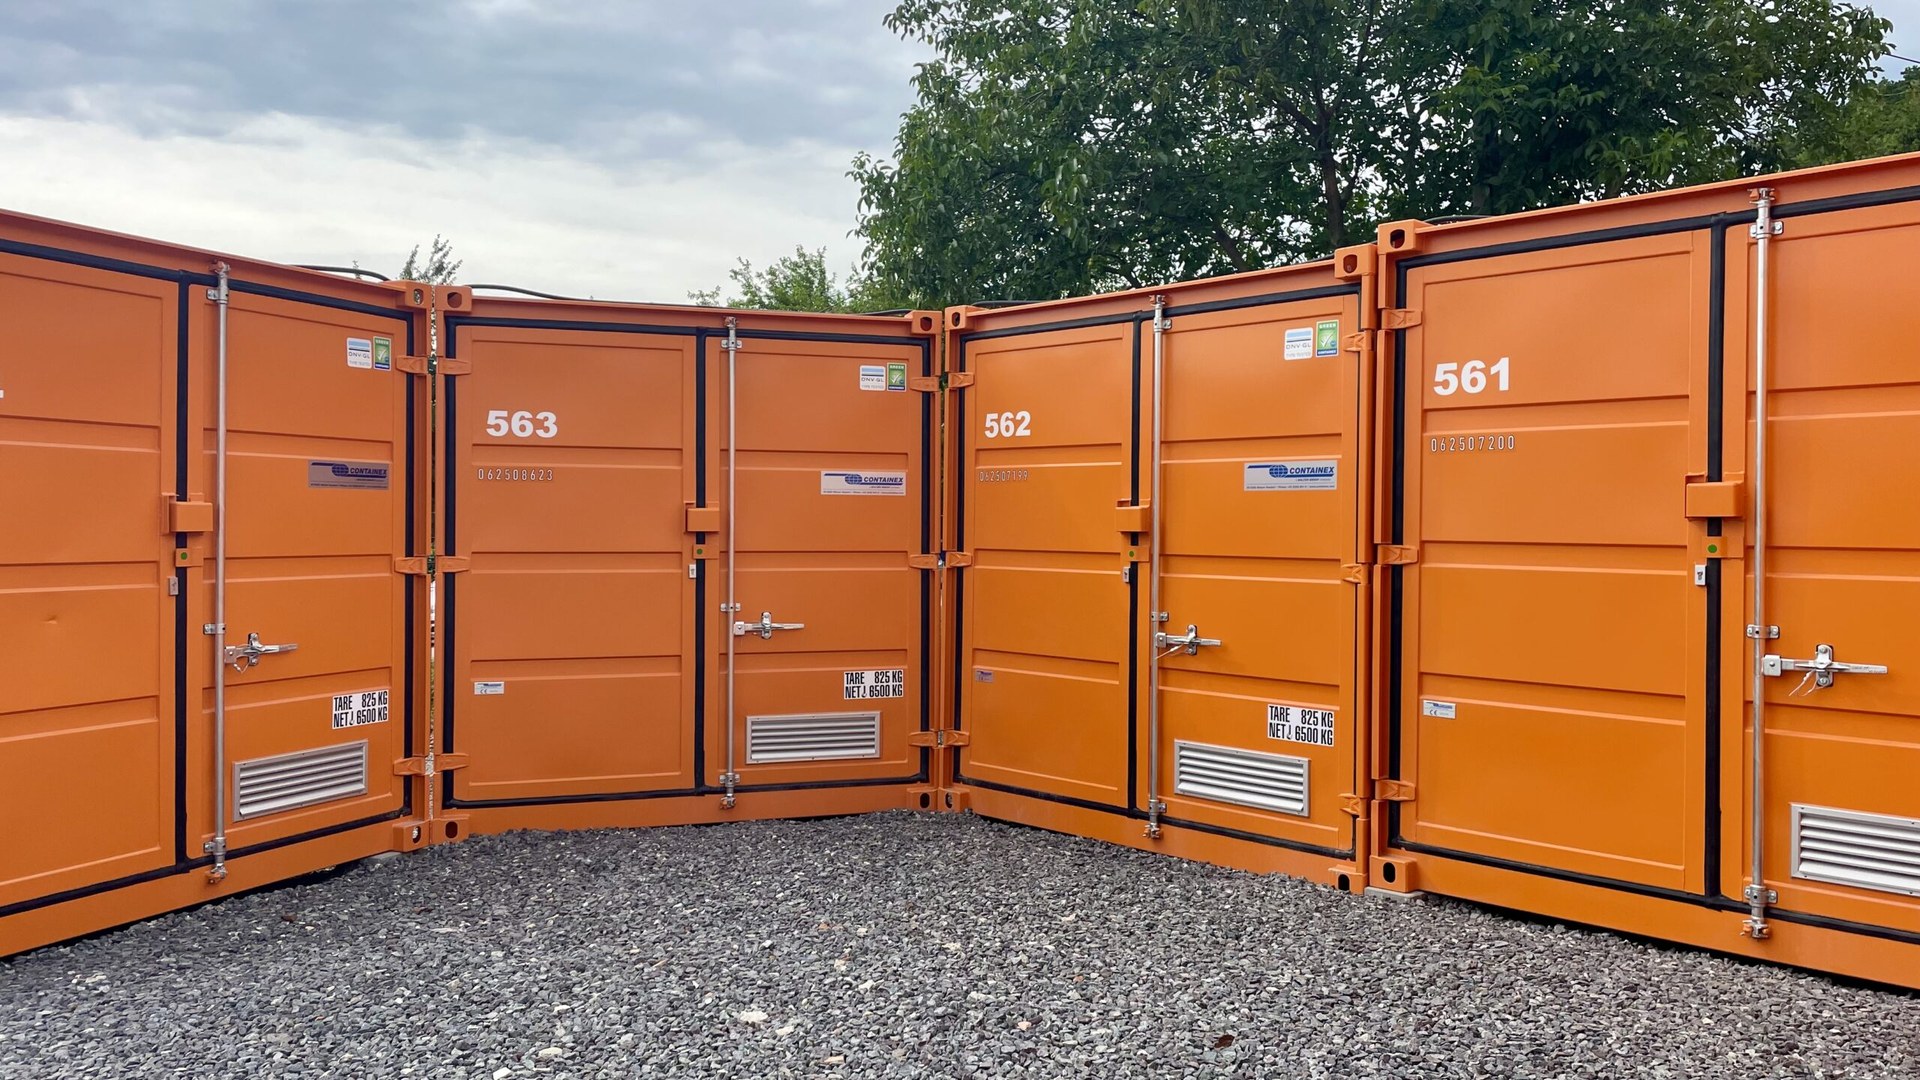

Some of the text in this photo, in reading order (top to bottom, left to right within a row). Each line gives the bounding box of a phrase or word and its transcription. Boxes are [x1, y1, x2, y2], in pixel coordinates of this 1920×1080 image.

[1433, 356, 1510, 396] 561
[486, 410, 558, 438] 563
[984, 411, 1031, 438] 562
[1431, 435, 1514, 452] 062507200
[350, 467, 388, 476] CONTAINEX
[478, 468, 553, 481] 062508623
[980, 470, 1029, 482] 062507199
[1289, 466, 1335, 475] CONTAINEX
[845, 670, 903, 685] TARE 825 KG
[845, 684, 903, 698] NET 6500 KG
[334, 691, 388, 711] TARE 825 KG
[334, 706, 388, 728] NET 6500 KG
[1269, 705, 1333, 729] TARE 825 KG
[1269, 722, 1333, 746] NET 6500 KG
